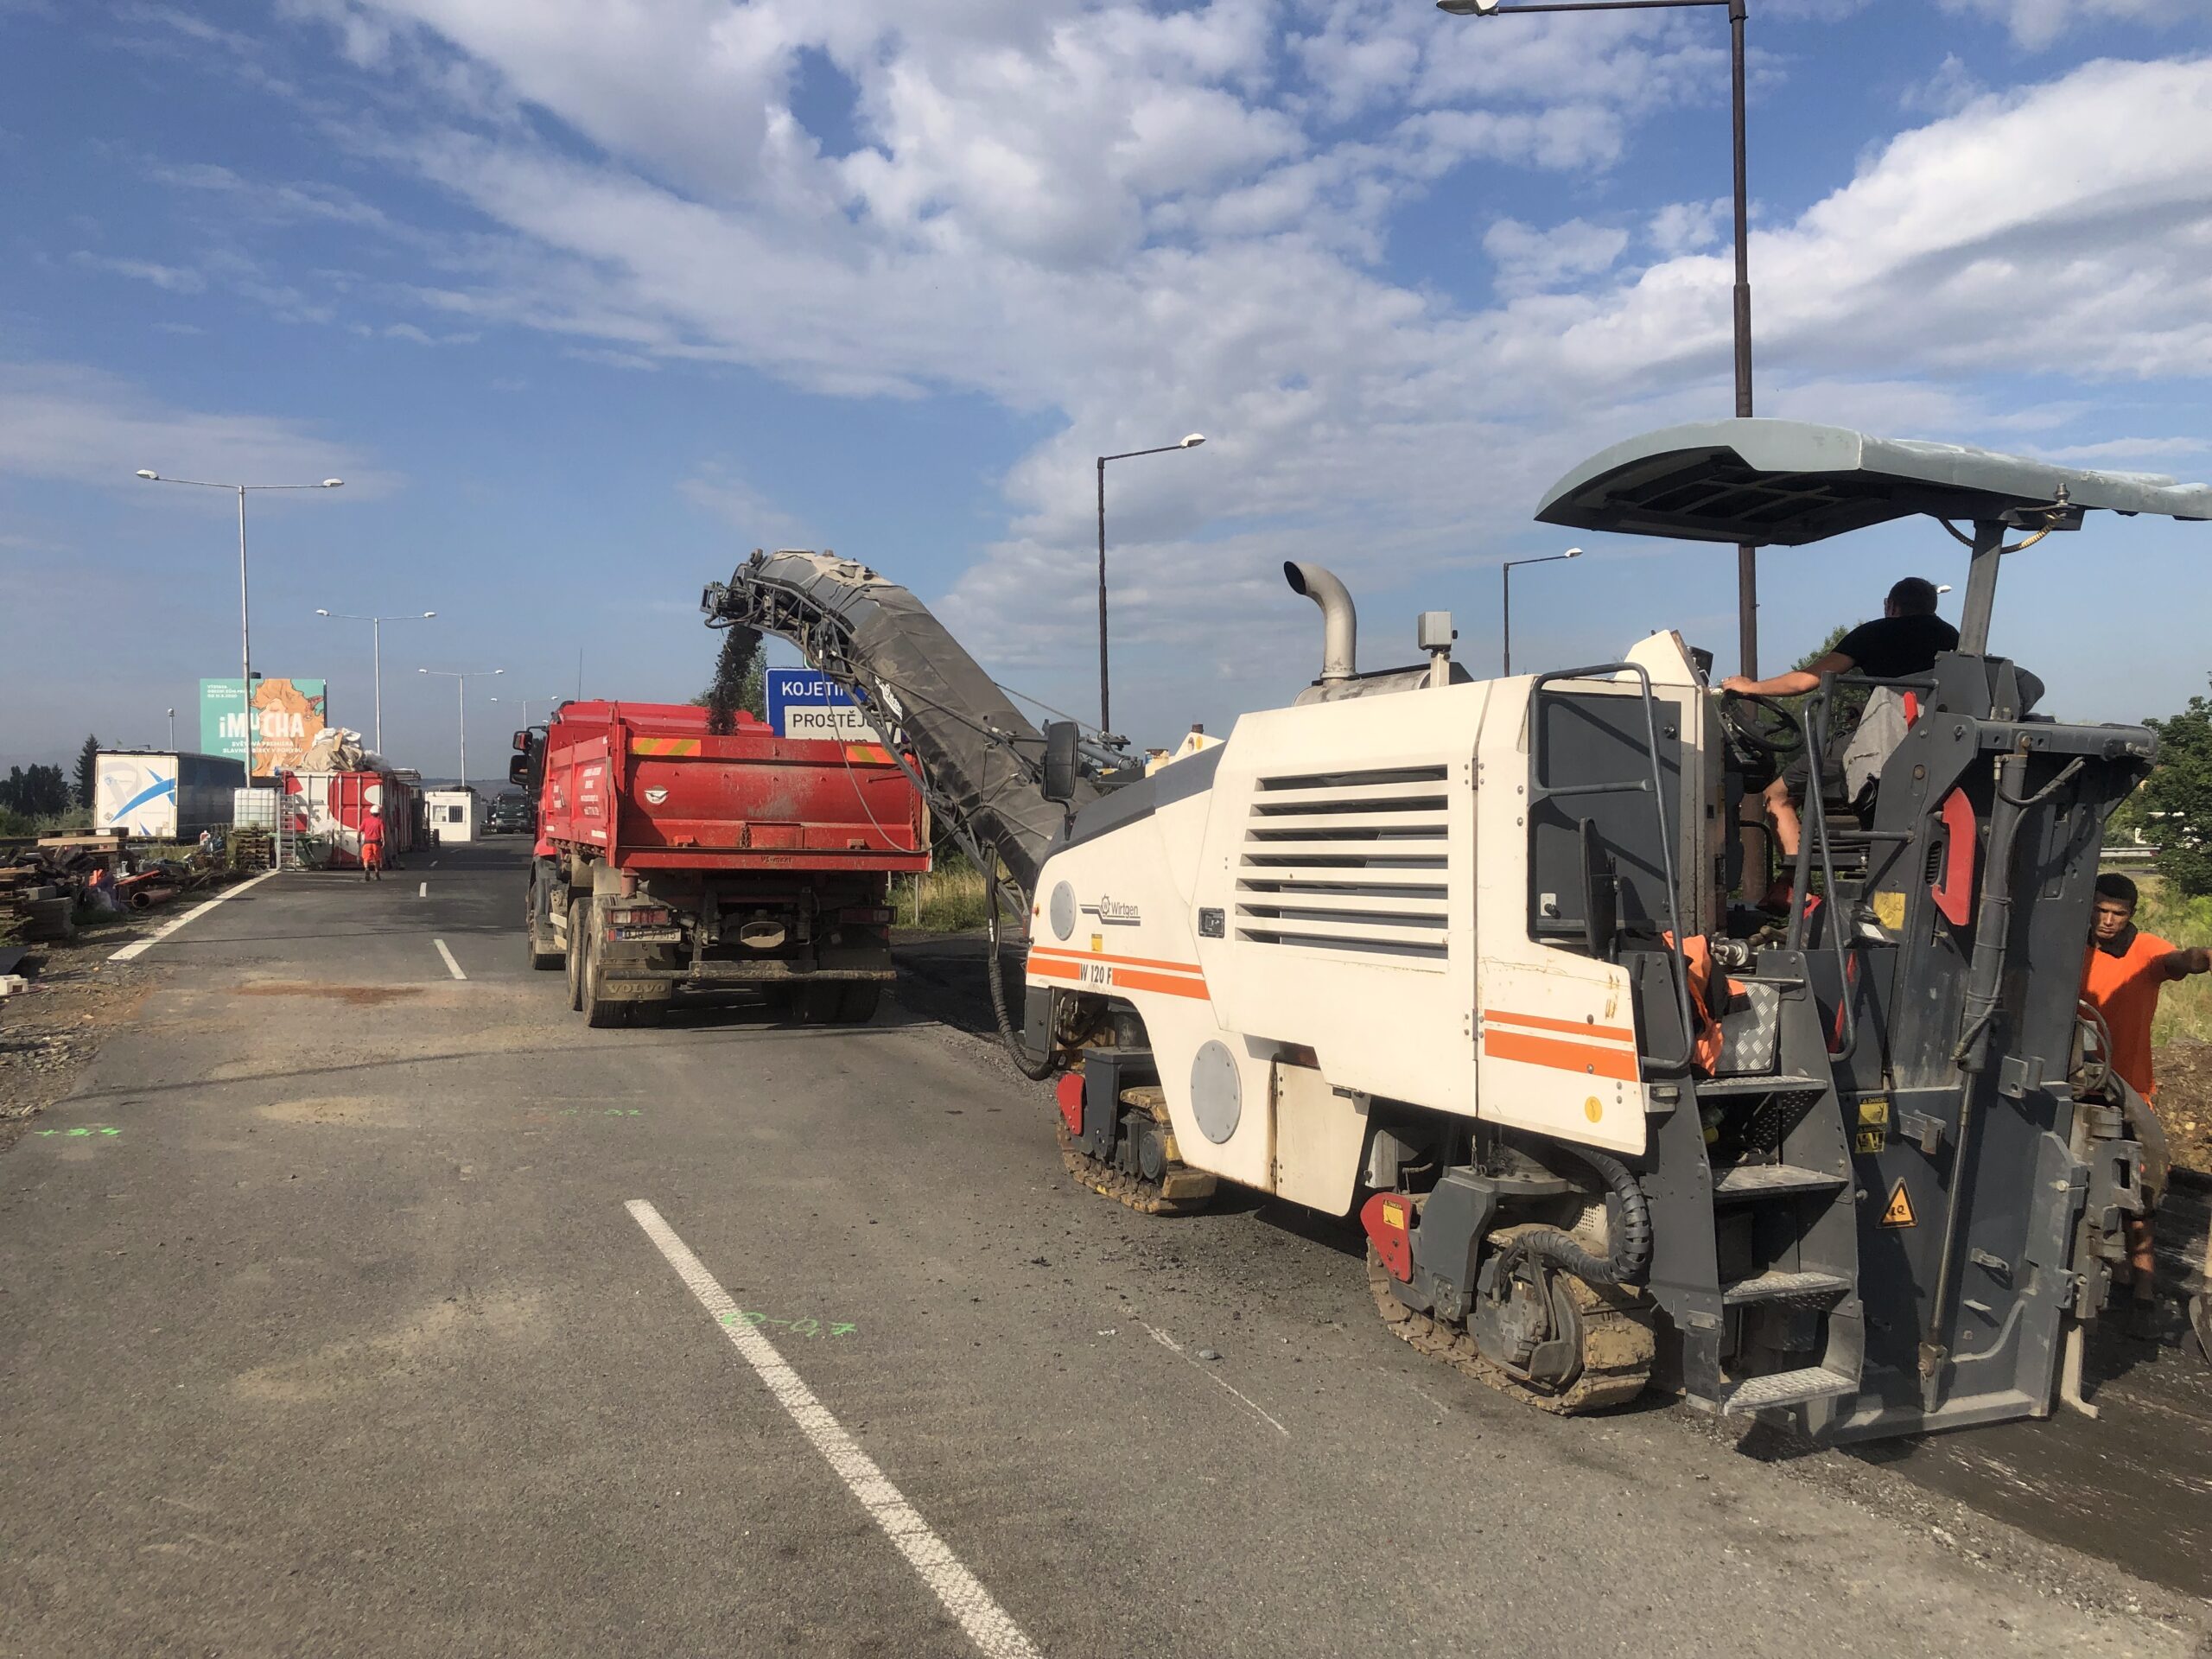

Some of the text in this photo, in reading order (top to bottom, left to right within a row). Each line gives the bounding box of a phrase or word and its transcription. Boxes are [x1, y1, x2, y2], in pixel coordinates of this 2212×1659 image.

[1111, 901, 1139, 918] Wirtgen
[1080, 963, 1112, 984] W 120 F
[607, 983, 666, 994] VOLVO
